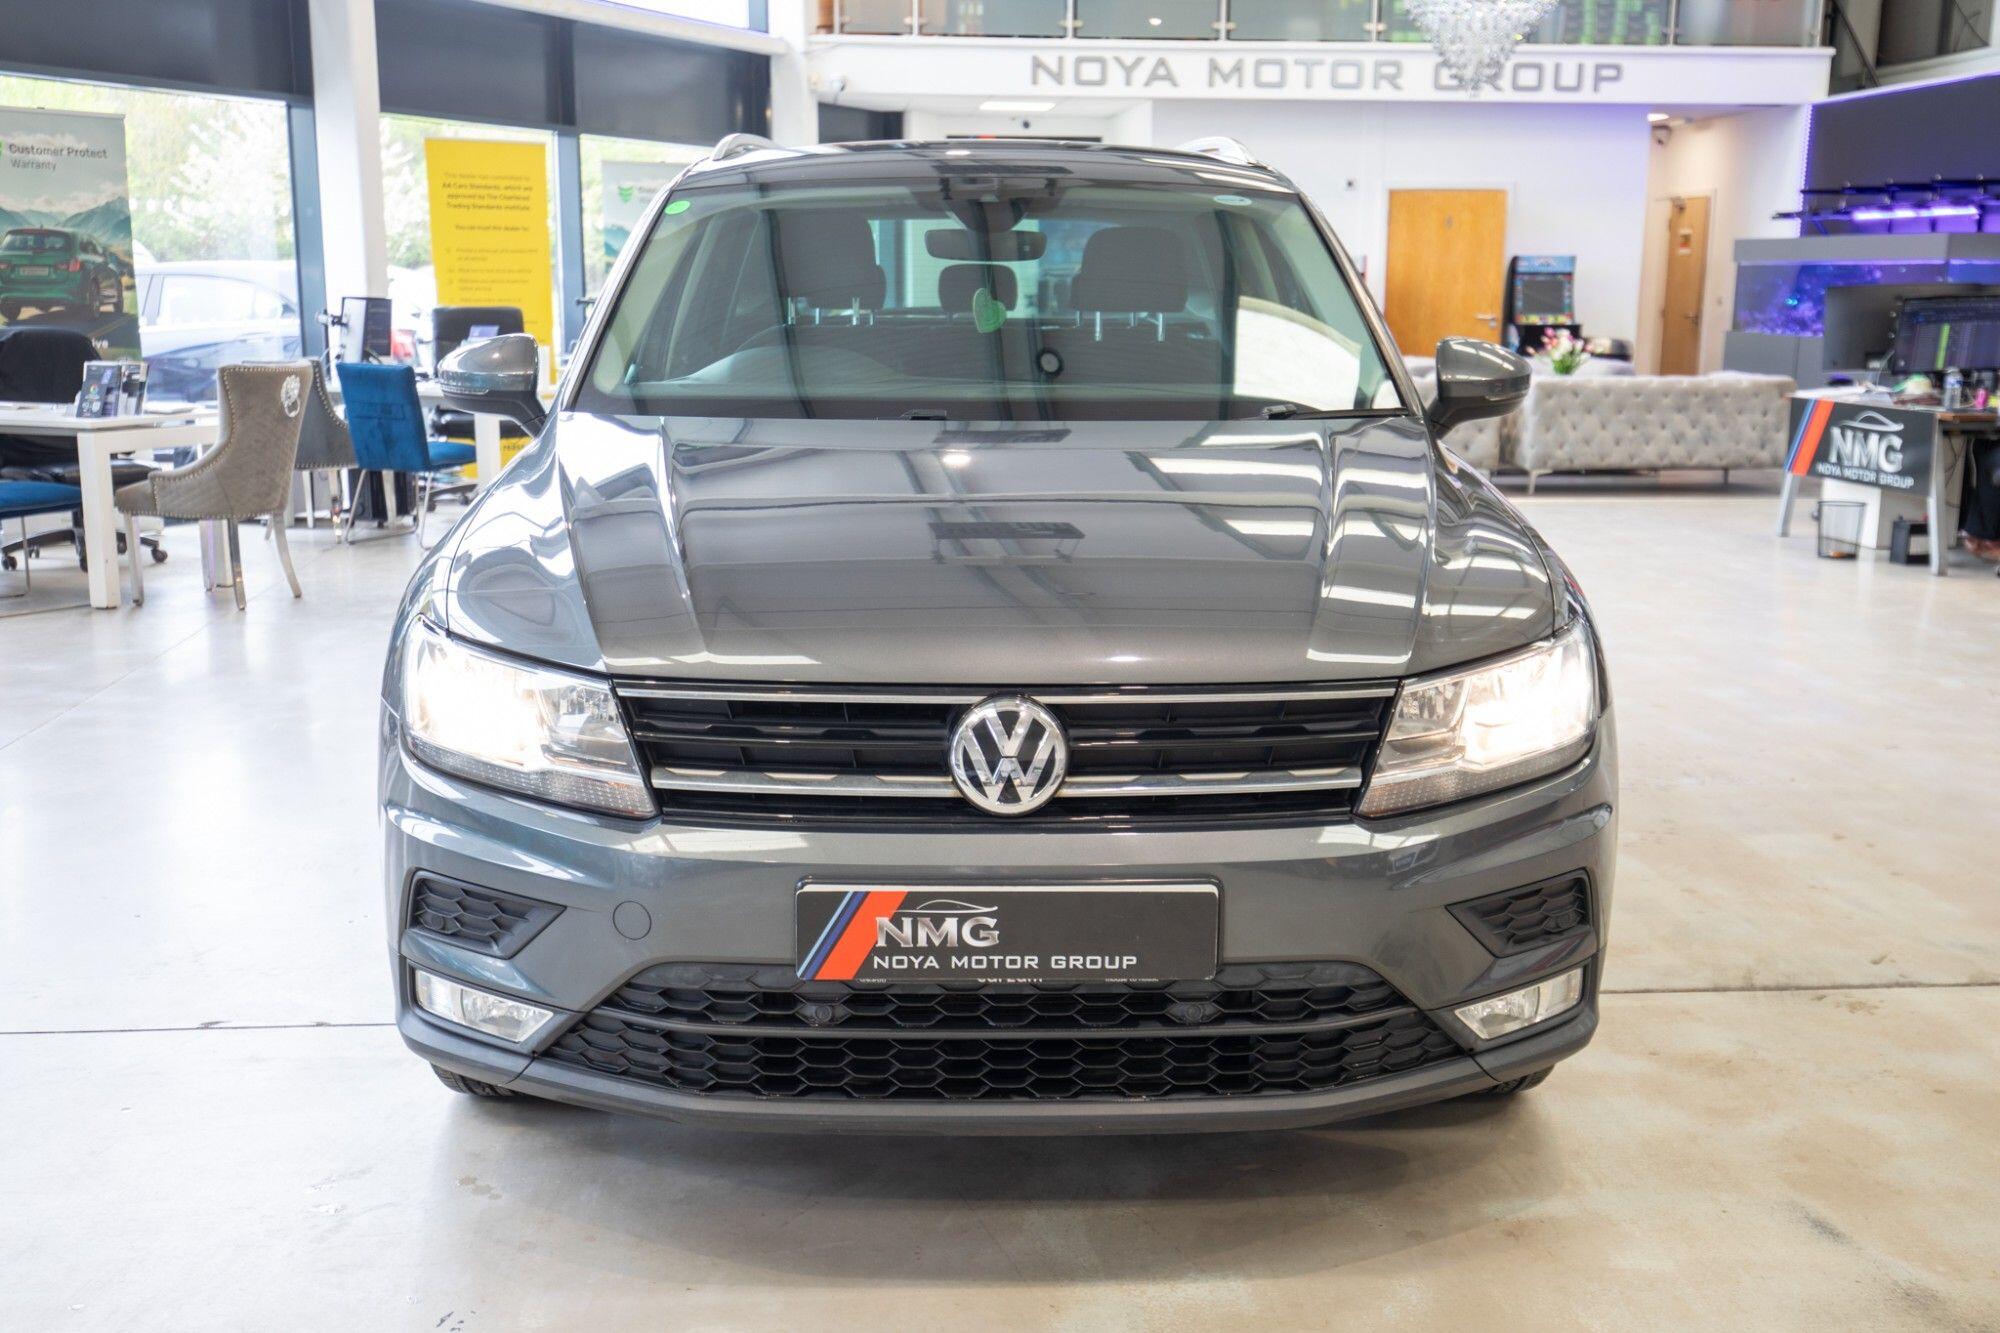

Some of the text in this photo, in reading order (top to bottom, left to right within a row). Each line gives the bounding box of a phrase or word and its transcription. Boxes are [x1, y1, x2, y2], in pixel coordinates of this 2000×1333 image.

[1031, 54, 1624, 93] NOYA MOTOR GROUP
[9, 143, 108, 159] Customer Protect
[10, 159, 57, 171] Warranty
[1828, 426, 1904, 473] NMG
[1816, 462, 1915, 489] NOYA MOTOR GROUP
[875, 916, 1000, 948] NMG
[873, 955, 1138, 970] NOYA MOTOR GROUP
